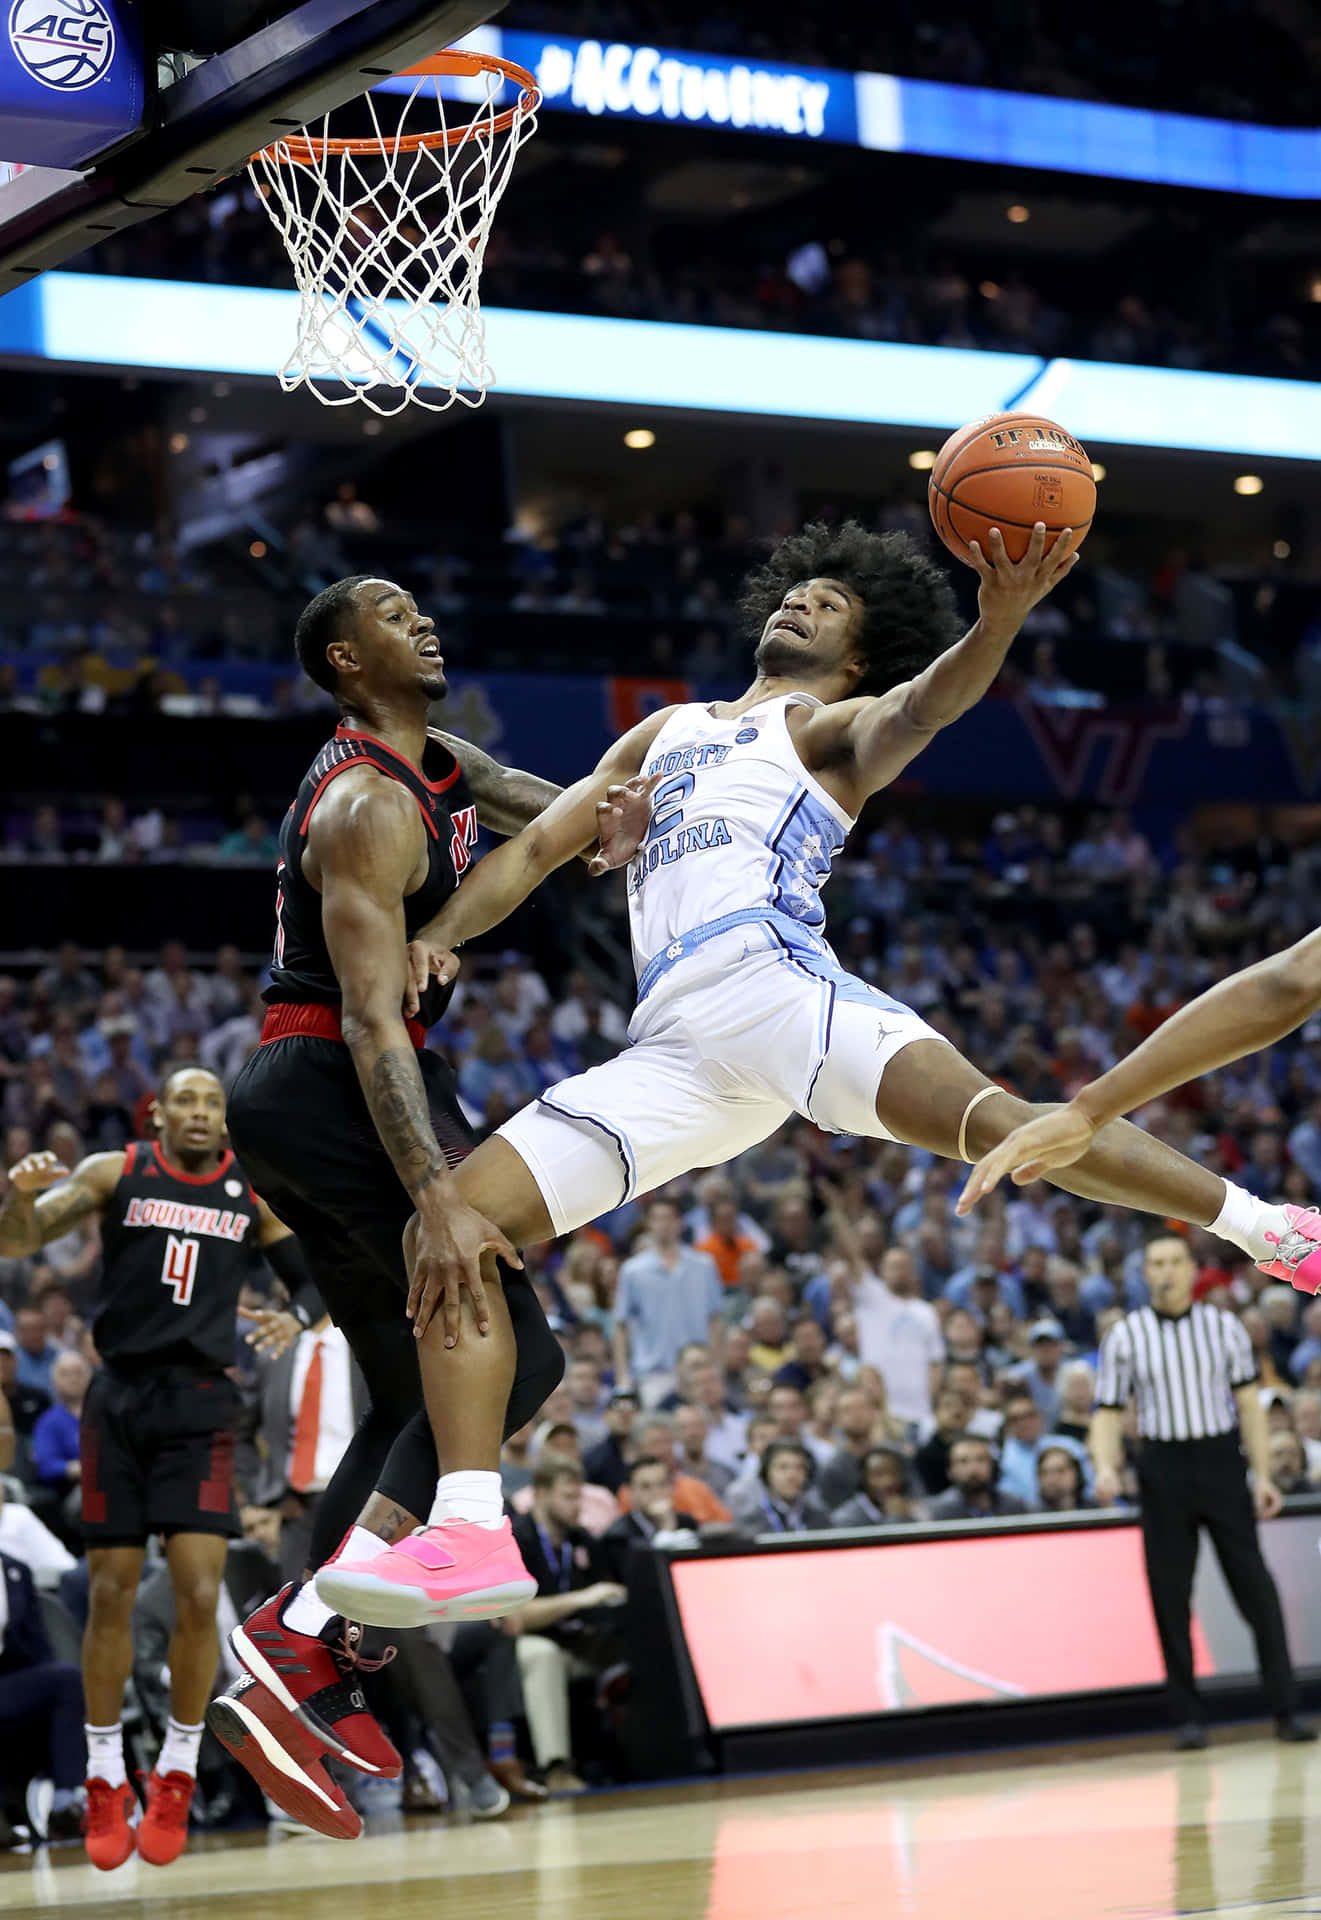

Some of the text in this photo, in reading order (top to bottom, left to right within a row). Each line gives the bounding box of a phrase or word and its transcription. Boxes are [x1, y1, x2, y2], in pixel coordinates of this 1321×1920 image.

[22, 14, 110, 46] ACC
[648, 744, 733, 778] NORTH
[645, 771, 696, 847] 2
[123, 1197, 250, 1243] LOUISVILLE
[161, 1234, 200, 1307] 4
